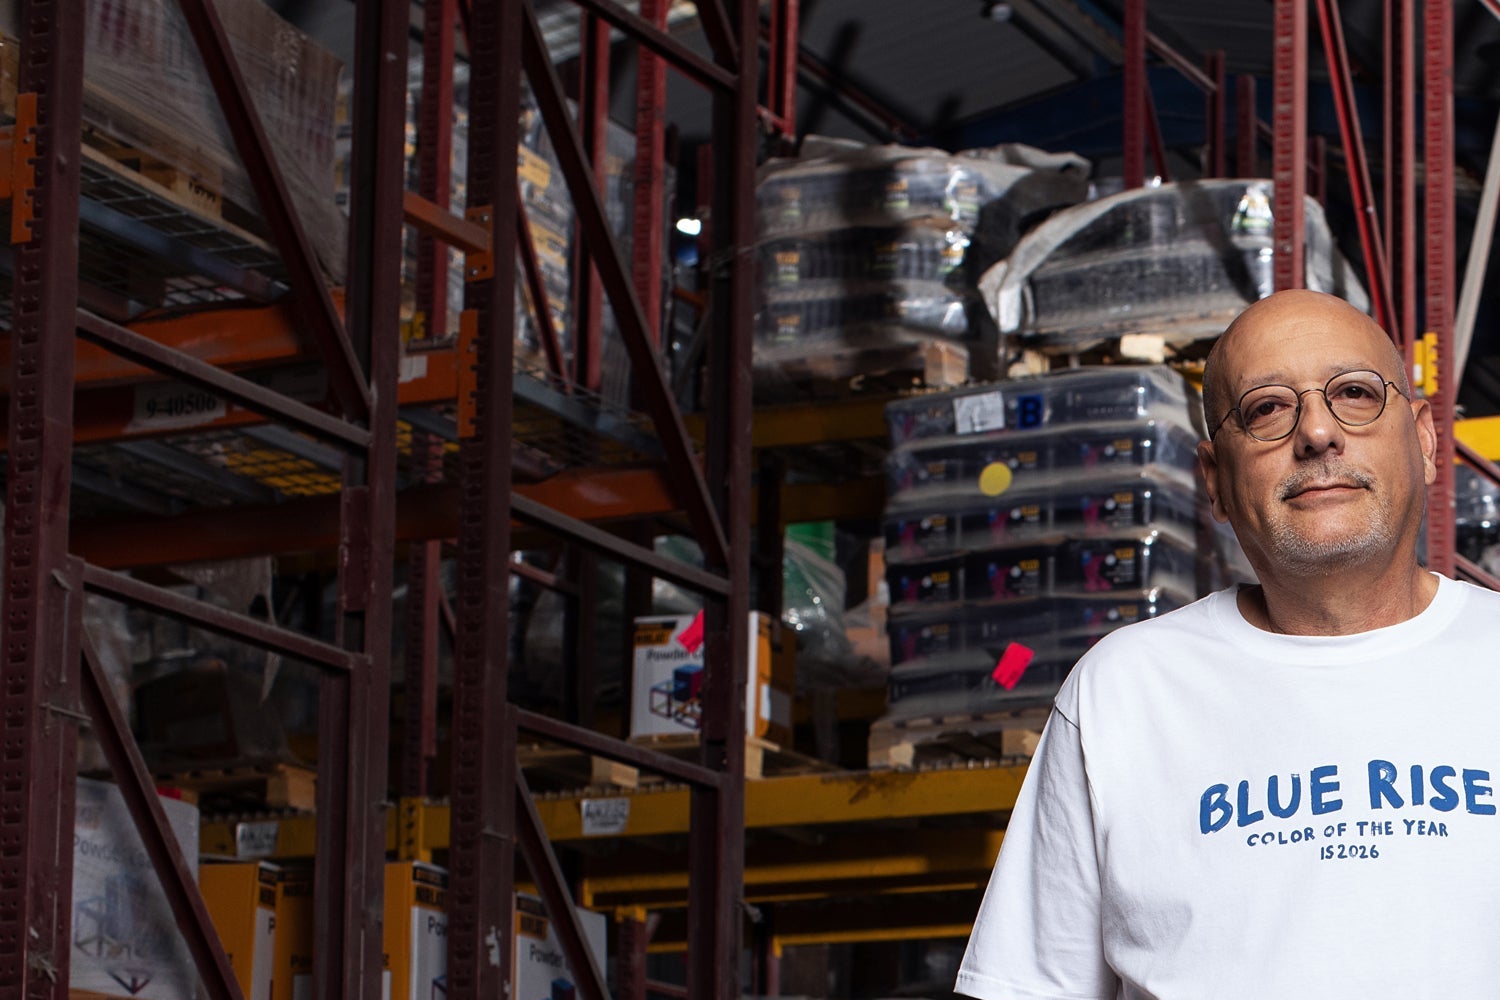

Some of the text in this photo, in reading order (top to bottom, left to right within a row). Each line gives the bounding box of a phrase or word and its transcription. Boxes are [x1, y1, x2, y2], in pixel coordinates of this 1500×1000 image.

[1200, 759, 1497, 835] BLUE RISE
[1247, 818, 1449, 847] COLOR OF THE YEAR
